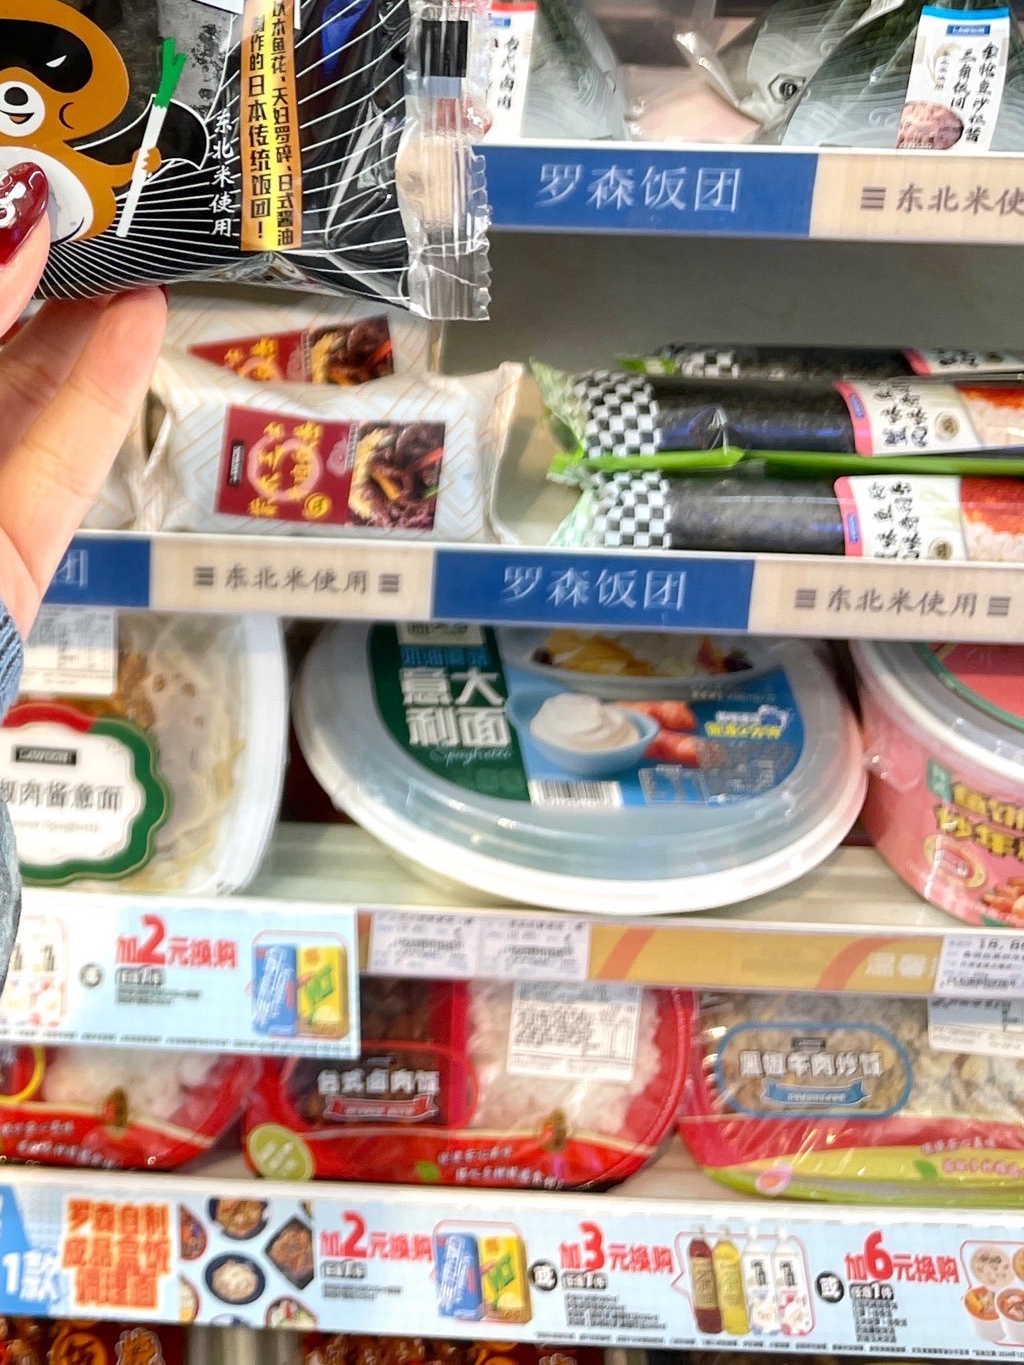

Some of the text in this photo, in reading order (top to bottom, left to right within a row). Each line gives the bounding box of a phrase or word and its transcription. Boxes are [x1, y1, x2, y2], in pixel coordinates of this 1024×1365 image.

[211, 109, 235, 238] 东北米使用
[534, 162, 742, 215] 罗森饭团
[224, 561, 370, 596] 东北米使用
[502, 563, 688, 612] 罗森饭团
[827, 585, 980, 619] 东北米使用
[399, 667, 505, 706] 意大
[406, 706, 512, 747] 利面
[115, 913, 239, 970] 加2元换购
[320, 1210, 434, 1262] 加2元换购
[558, 1221, 676, 1274] 加3元换购
[844, 1230, 960, 1284] 加6元换购
